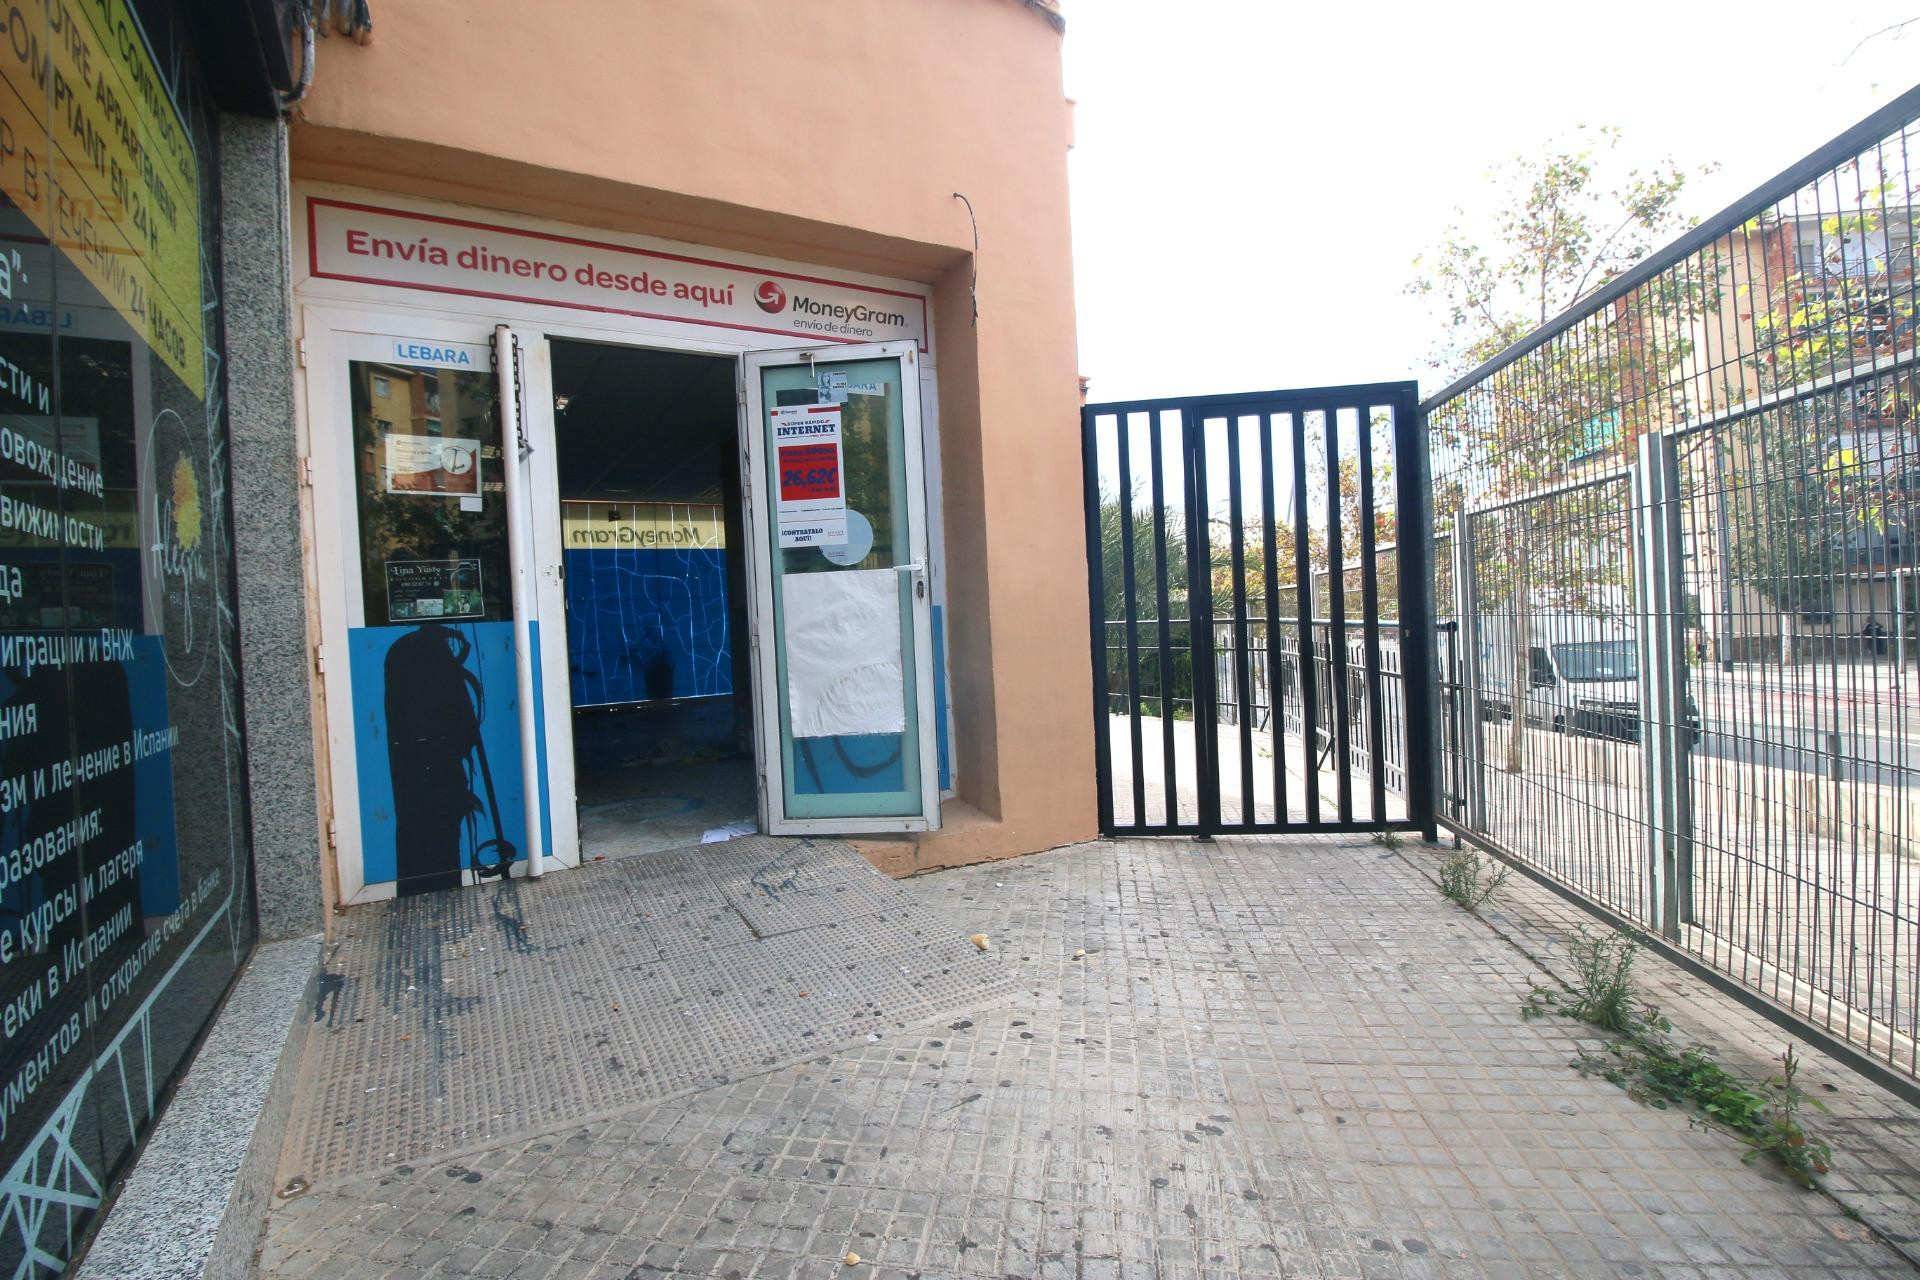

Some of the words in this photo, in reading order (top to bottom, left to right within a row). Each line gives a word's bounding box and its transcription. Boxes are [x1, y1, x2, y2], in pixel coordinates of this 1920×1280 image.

[0, 6, 106, 178] OMPTANT
[111, 153, 129, 214] EN
[133, 190, 147, 240] 24
[95, 71, 177, 233] APPARTEMENT
[129, 273, 146, 325] 24
[345, 229, 449, 267] Envía
[456, 246, 568, 283] dinero
[574, 263, 667, 297] desde
[673, 283, 735, 309] aquí
[792, 295, 905, 327] MoneyGram
[824, 322, 839, 332] de
[839, 324, 873, 337] dinero
[397, 344, 470, 366] LEBARA
[777, 423, 836, 436] INTERNET
[88, 636, 98, 663] и
[102, 627, 135, 663] ВНЖ
[33, 767, 46, 801] и
[51, 742, 121, 795] лечение
[123, 740, 132, 766] в
[133, 724, 179, 761] Испании
[20, 883, 78, 953] курсы
[83, 872, 95, 904] и
[98, 839, 144, 894] лагеря
[0, 978, 43, 1039] еки
[48, 963, 59, 1001] в
[63, 901, 133, 984] Испании
[100, 928, 161, 1012] открытие
[163, 897, 191, 942] счета
[191, 890, 198, 913] в
